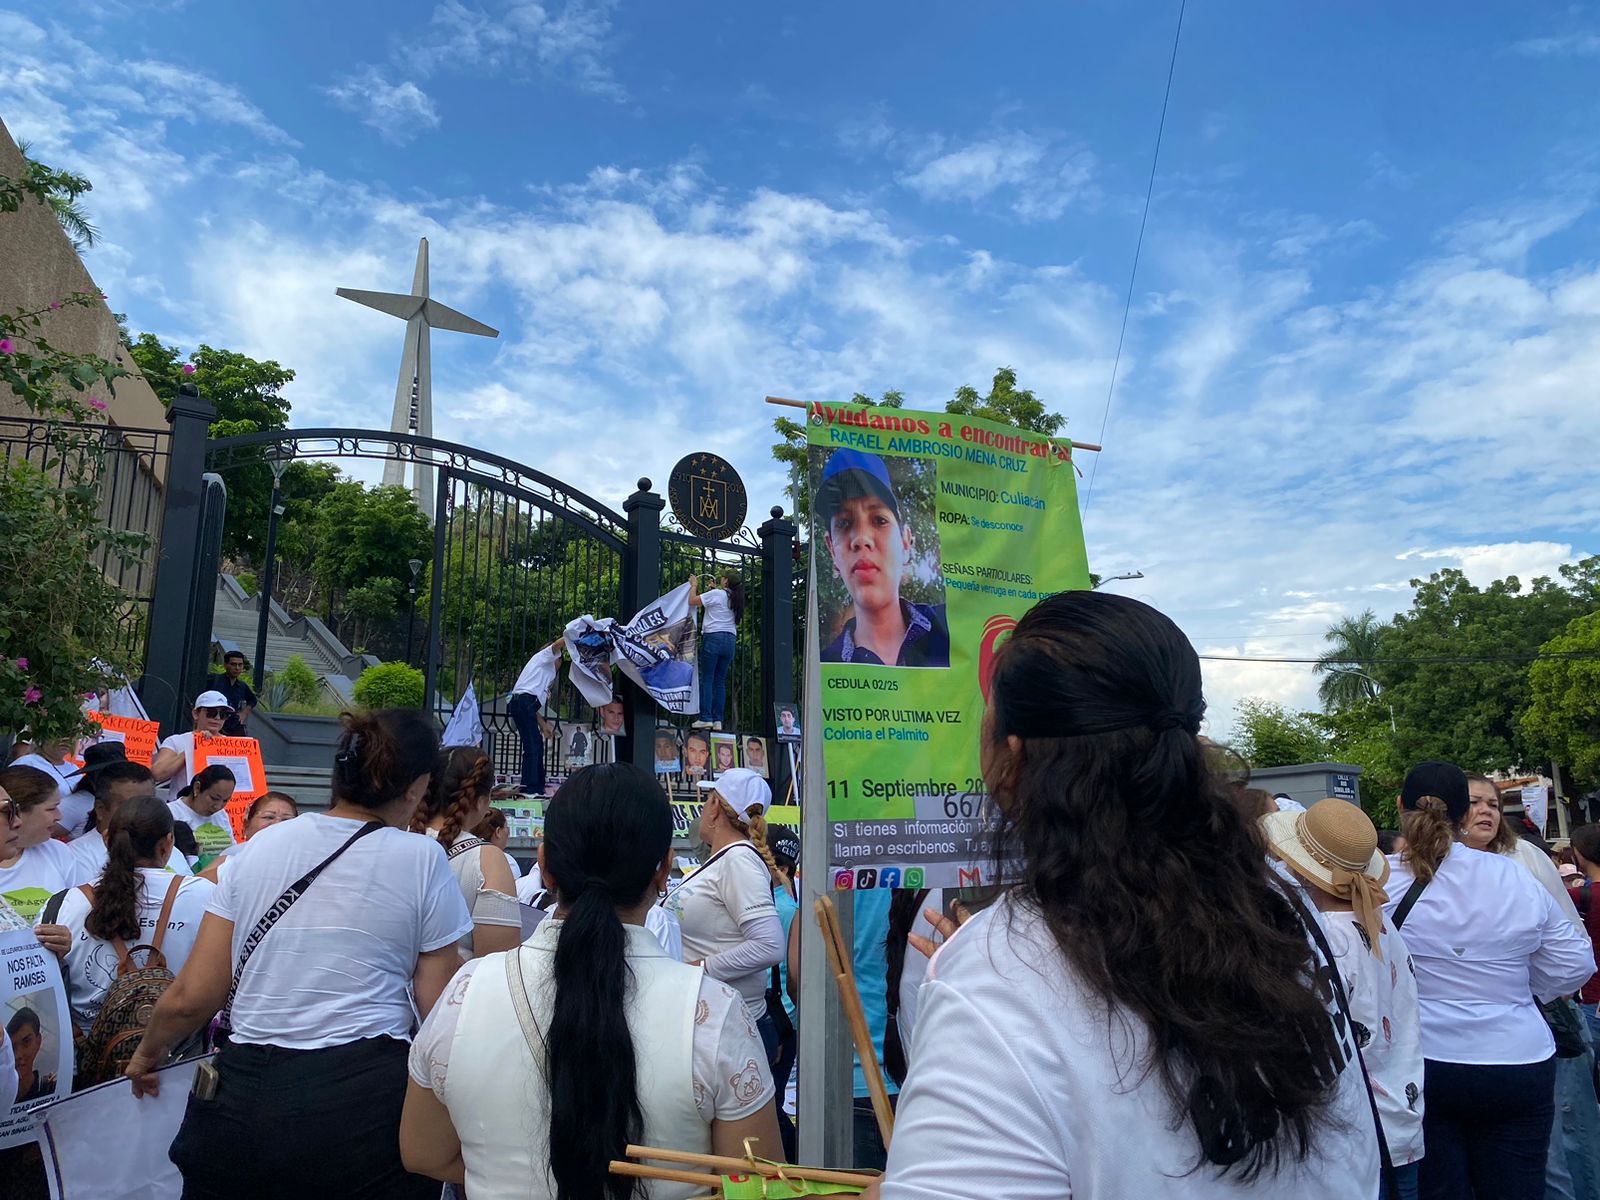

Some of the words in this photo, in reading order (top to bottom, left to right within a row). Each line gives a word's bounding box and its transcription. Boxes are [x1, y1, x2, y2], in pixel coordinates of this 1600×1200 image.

[809, 401, 930, 435] Ayúdanos
[938, 422, 953, 438] a
[960, 425, 1071, 461] encontrara
[830, 428, 885, 450] RAFAEL
[887, 436, 962, 459] AMBROSIO
[965, 447, 997, 466] MENA
[999, 455, 1028, 472] CRUZ
[941, 481, 999, 503] MUNICIPIO:
[1000, 491, 1046, 510] Culiacán
[939, 511, 970, 526] ROPA:
[971, 515, 980, 526] Se
[980, 518, 1024, 533] desconoce
[942, 562, 975, 576] SEÑAS
[976, 566, 1033, 585] PARTICULARES:
[945, 578, 980, 592] Pequeña
[981, 585, 1006, 598] verruga
[1007, 588, 1017, 598] en
[1019, 588, 1037, 600] cada
[827, 678, 870, 690] CEDULA
[872, 679, 899, 692] 02/25
[822, 708, 863, 722] VISTO
[865, 708, 890, 722] POR
[891, 709, 935, 724] ULTIMA
[936, 710, 962, 724] VEZ
[823, 726, 873, 741] Colonia
[875, 727, 885, 741] el
[888, 727, 929, 742] Palmito
[827, 780, 849, 799] 11
[861, 778, 957, 801] Septiembre
[965, 778, 985, 795] 20
[943, 793, 985, 818] 667
[834, 823, 848, 838] Si
[855, 821, 897, 836] tienes
[904, 819, 973, 835] información
[835, 843, 871, 858] llama
[875, 847, 884, 856] o
[887, 841, 958, 855] escribenos.
[139, 917, 184, 931] Esn?
[7, 957, 26, 974] NOS
[25, 954, 46, 970] FALTA
[13, 970, 46, 991] RAMSES
